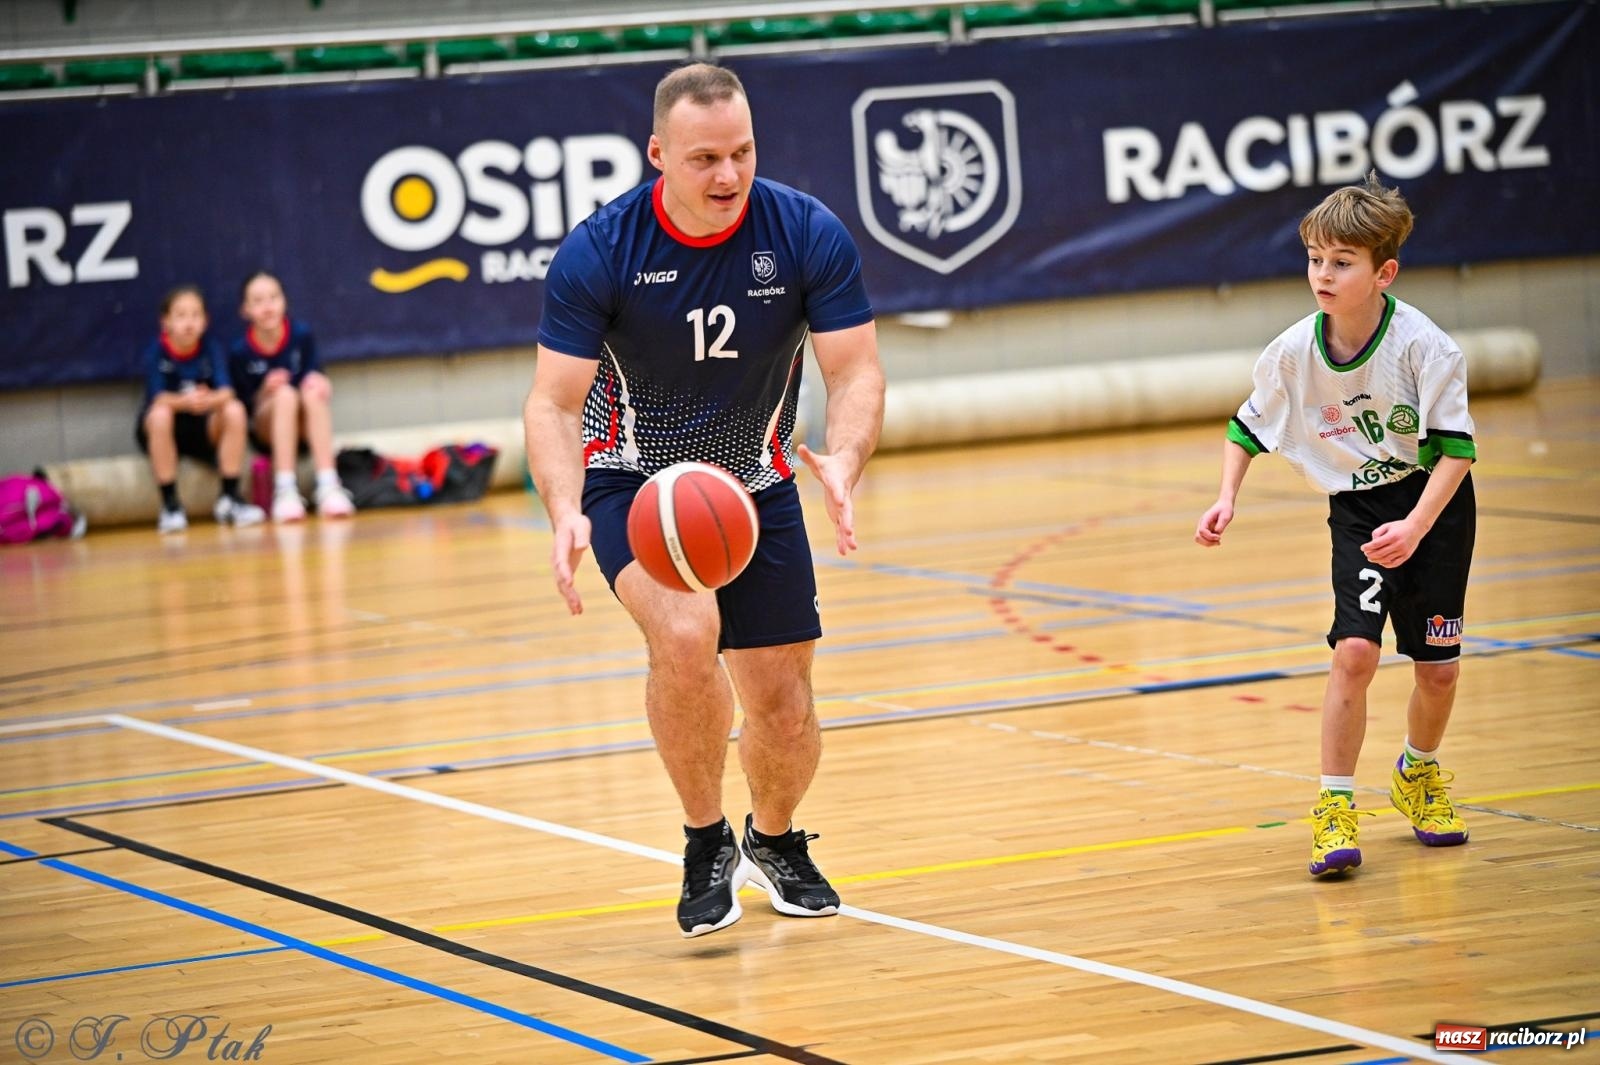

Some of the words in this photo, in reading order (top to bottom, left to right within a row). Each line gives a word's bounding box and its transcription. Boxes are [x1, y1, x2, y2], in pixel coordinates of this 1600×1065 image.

[1103, 80, 1550, 203] RACIBÓRZ
[481, 246, 560, 283] RAC
[747, 286, 786, 297] RACIBÓRZ
[686, 304, 738, 361] 12
[1319, 425, 1357, 439] Racibórz
[1351, 463, 1397, 490] AGR
[1358, 567, 1384, 614] 2
